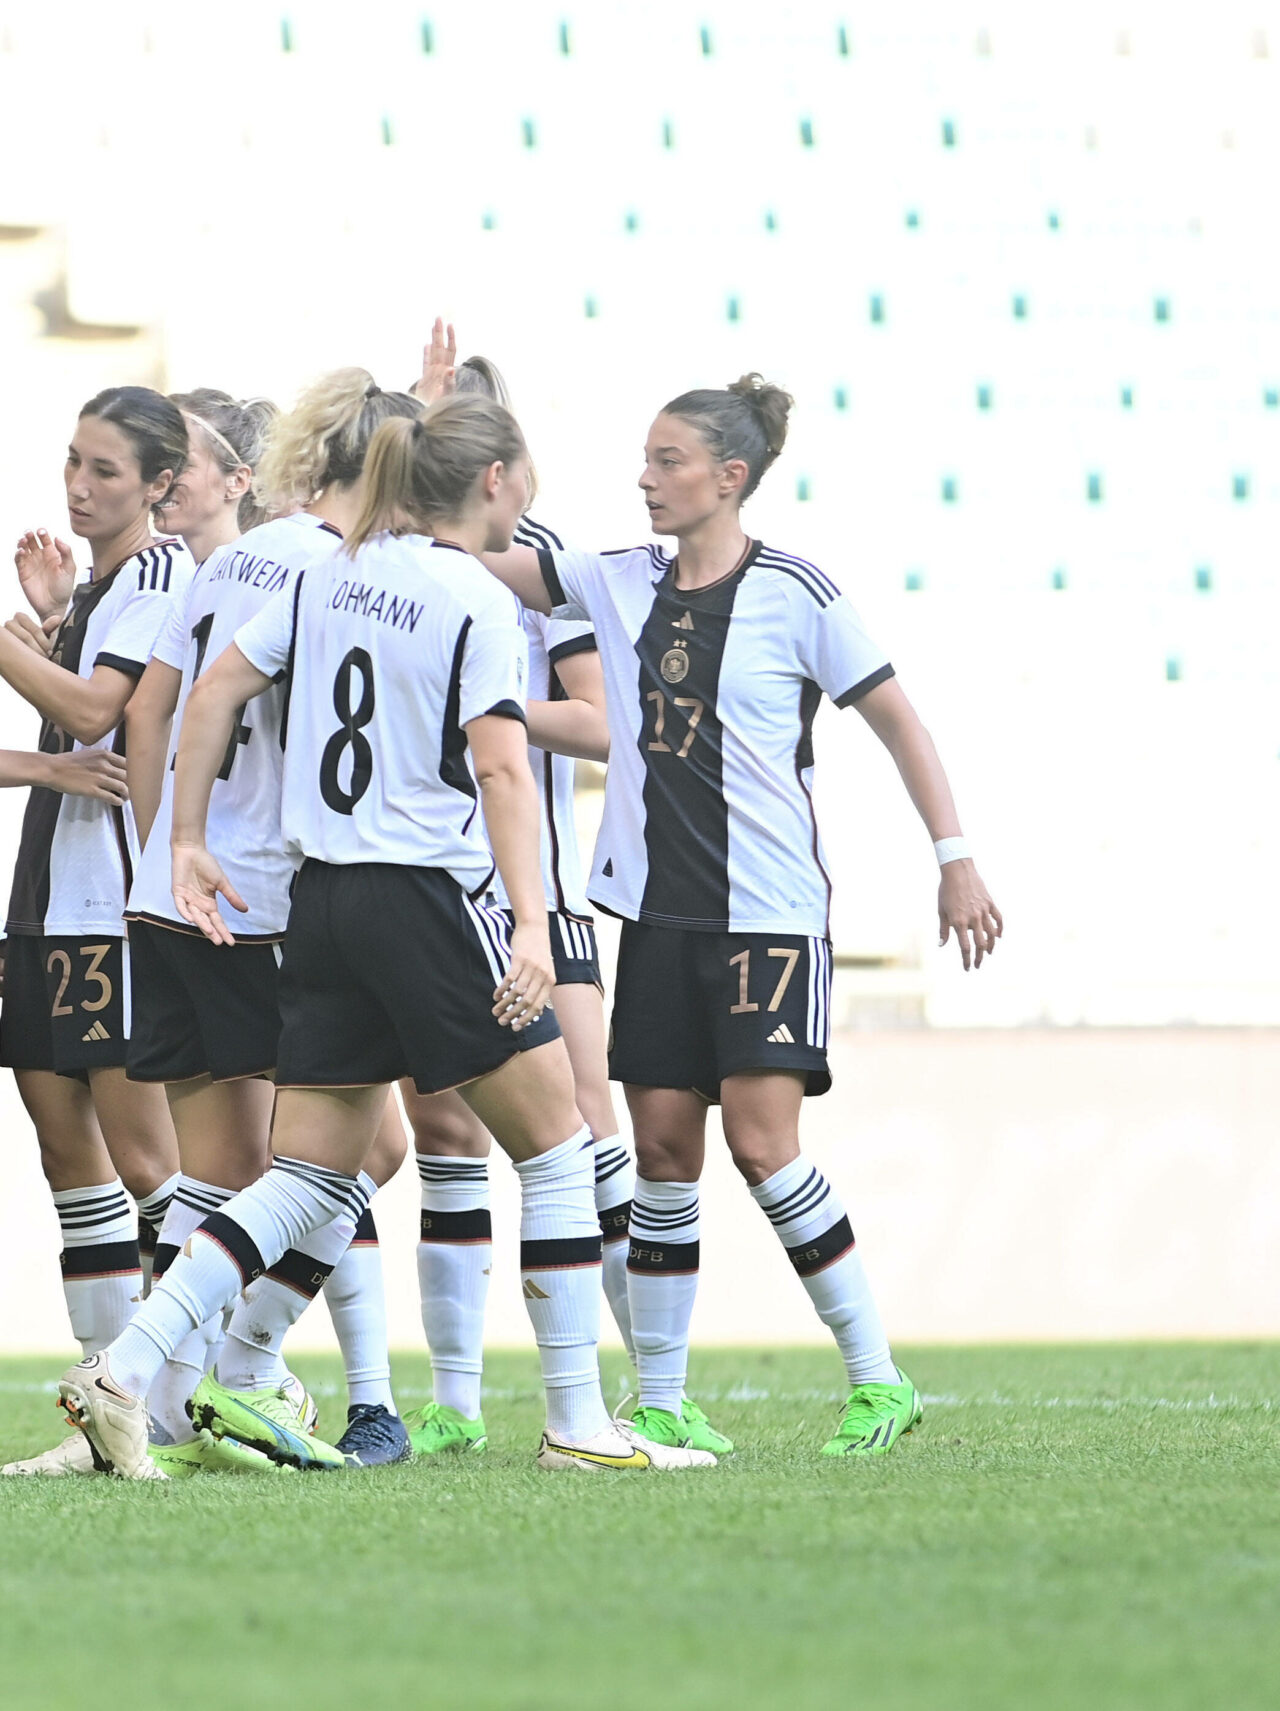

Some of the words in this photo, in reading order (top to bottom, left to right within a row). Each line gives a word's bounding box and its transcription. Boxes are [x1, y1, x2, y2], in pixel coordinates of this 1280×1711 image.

[319, 646, 375, 815] 8
[646, 690, 704, 757] 17
[47, 944, 113, 1017] 23
[729, 947, 800, 1014] 17
[629, 1246, 664, 1263] DFB
